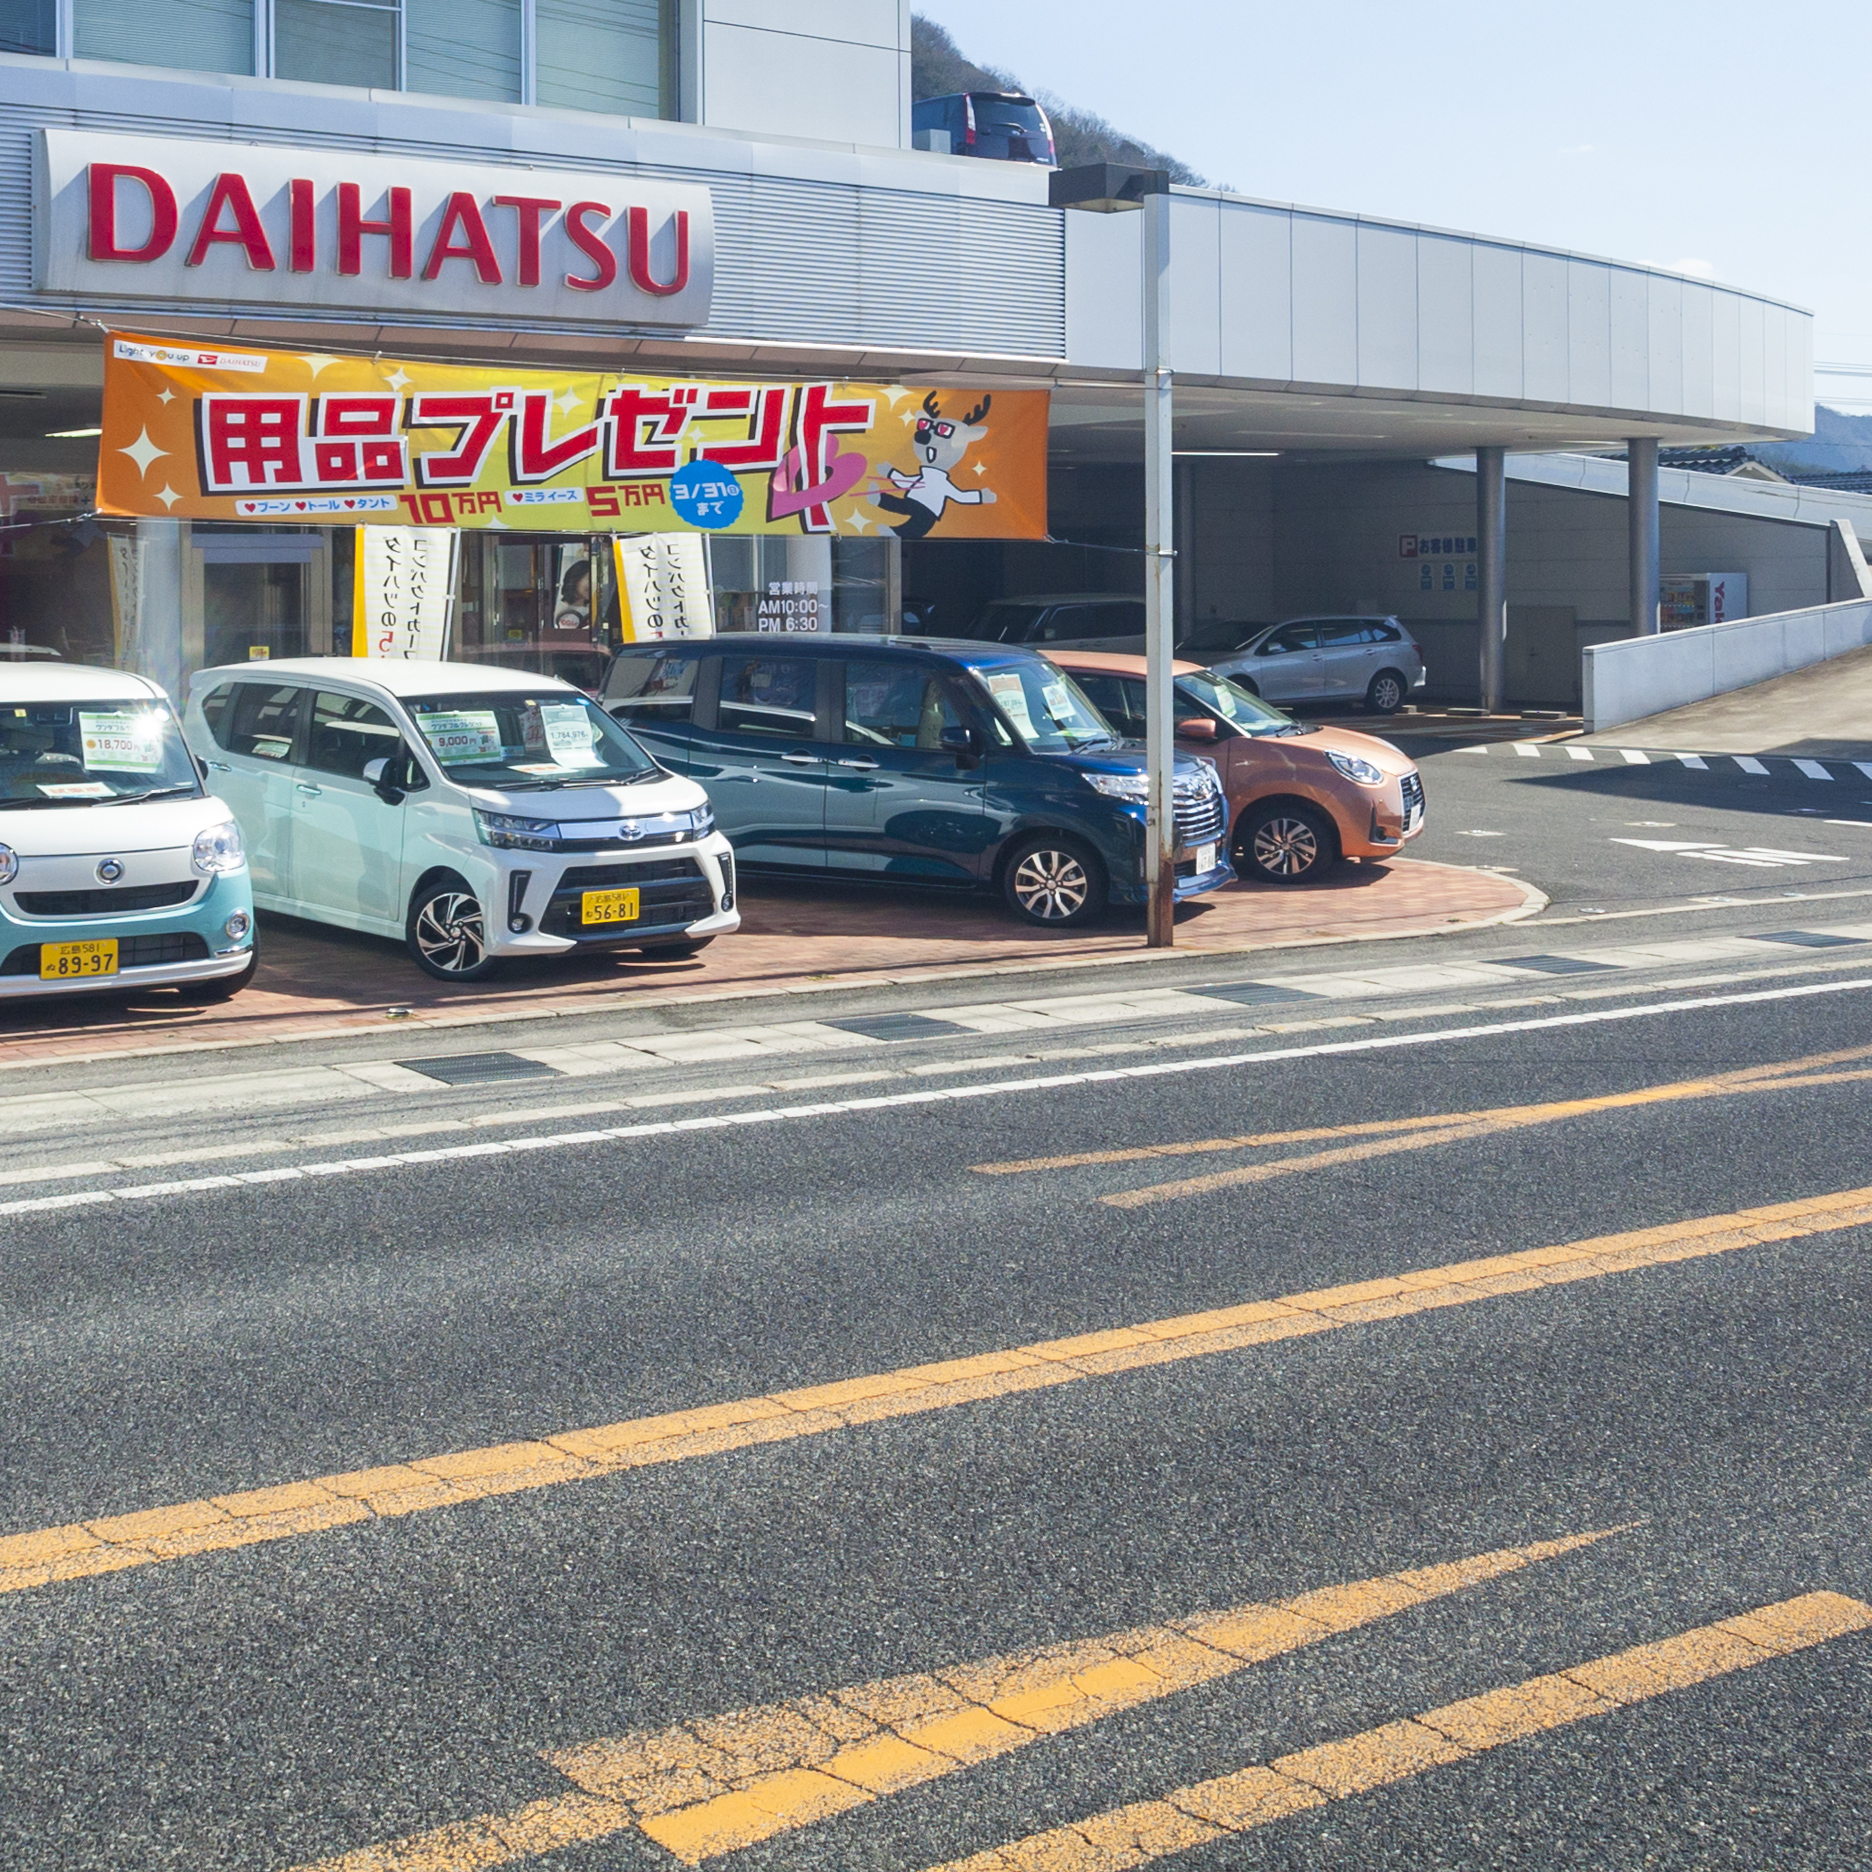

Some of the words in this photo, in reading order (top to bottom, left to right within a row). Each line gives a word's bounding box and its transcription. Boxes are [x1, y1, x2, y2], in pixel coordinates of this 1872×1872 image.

[86, 161, 690, 297] DAIHATSU
[219, 357, 262, 368] DAIHATSU
[203, 383, 871, 530] 用品プレゼント
[258, 501, 291, 513] ブーン
[308, 499, 341, 511] トール
[357, 498, 391, 509] タント
[399, 490, 503, 525] 10万円
[585, 483, 666, 518] 5万円
[696, 500, 725, 516] まで
[768, 581, 818, 595] 営業時間
[758, 617, 781, 632] PM
[785, 616, 818, 632] 6:30
[594, 902, 634, 920] 56-81
[82, 943, 100, 954] 581
[58, 953, 114, 975] 89-97
